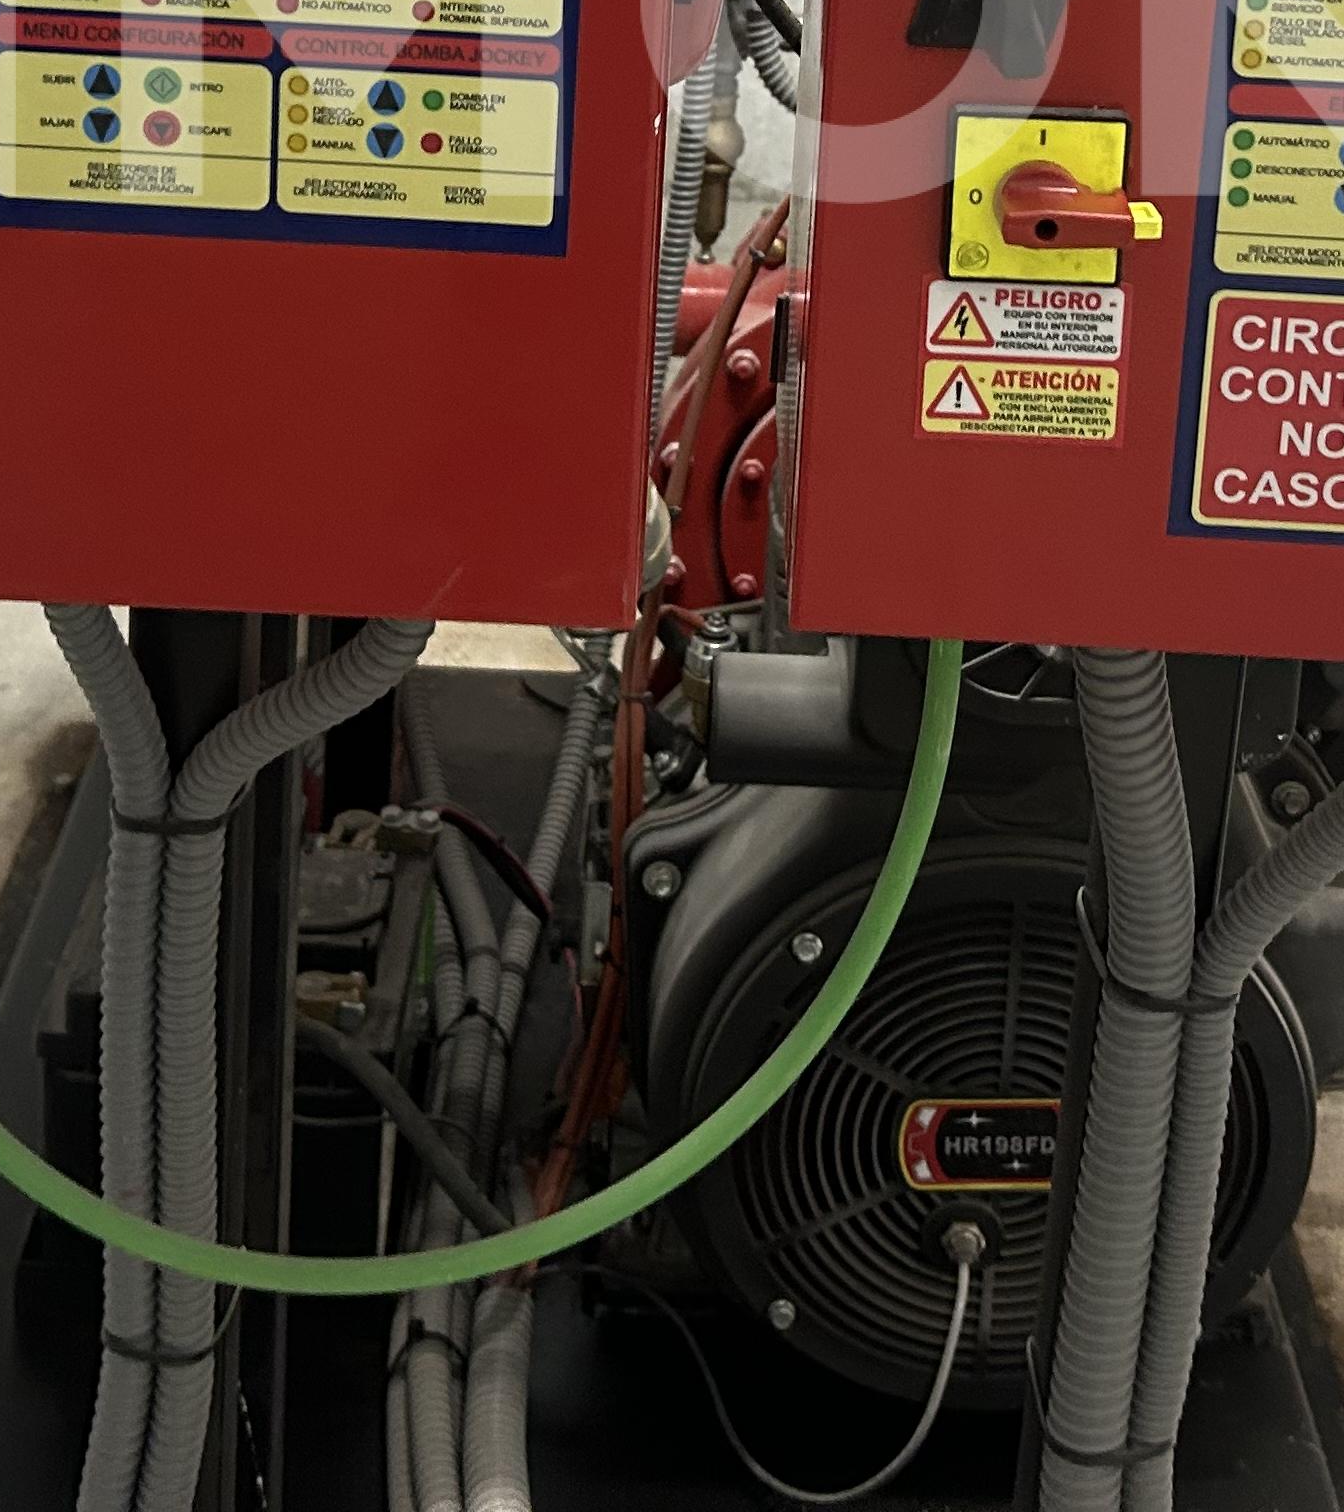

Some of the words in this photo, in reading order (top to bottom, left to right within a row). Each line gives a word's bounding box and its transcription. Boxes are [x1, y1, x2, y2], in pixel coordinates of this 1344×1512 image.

[23, 20, 78, 40] MENÚ
[84, 24, 244, 50] CONFIGURACIÓN
[294, 38, 388, 59] CONTROL
[396, 44, 467, 62] BOMBA
[470, 48, 546, 67] JOCKEY
[189, 83, 224, 93] INTRO
[40, 117, 75, 128] BAJAR
[312, 140, 356, 151] MANUAL
[1253, 193, 1297, 205] MANUAL
[994, 288, 1102, 311] PELIGRO
[1004, 310, 1043, 321] EQUIPO
[1045, 311, 1067, 321] CON
[1018, 321, 1032, 330] EN
[1035, 322, 1049, 331] SU
[1051, 322, 1098, 332] INTERIOR
[1000, 330, 1059, 341] MANIPULAR
[1092, 334, 1114, 343] POR
[995, 340, 1050, 352] PERSONAL
[1053, 342, 1118, 354] AUTORIZADO
[990, 368, 1101, 392] ATENCIÓN
[993, 392, 1064, 403] INTERRUPTOR
[1066, 395, 1114, 406] GENERAL
[999, 402, 1020, 412] CON
[993, 412, 1021, 422] PARA
[1057, 415, 1071, 424] LA
[1071, 416, 1111, 426] PUERTA
[960, 421, 1035, 434] DESCONECTAR
[1077, 426, 1086, 435] A
[944, 1136, 1056, 1155] HR198FD
